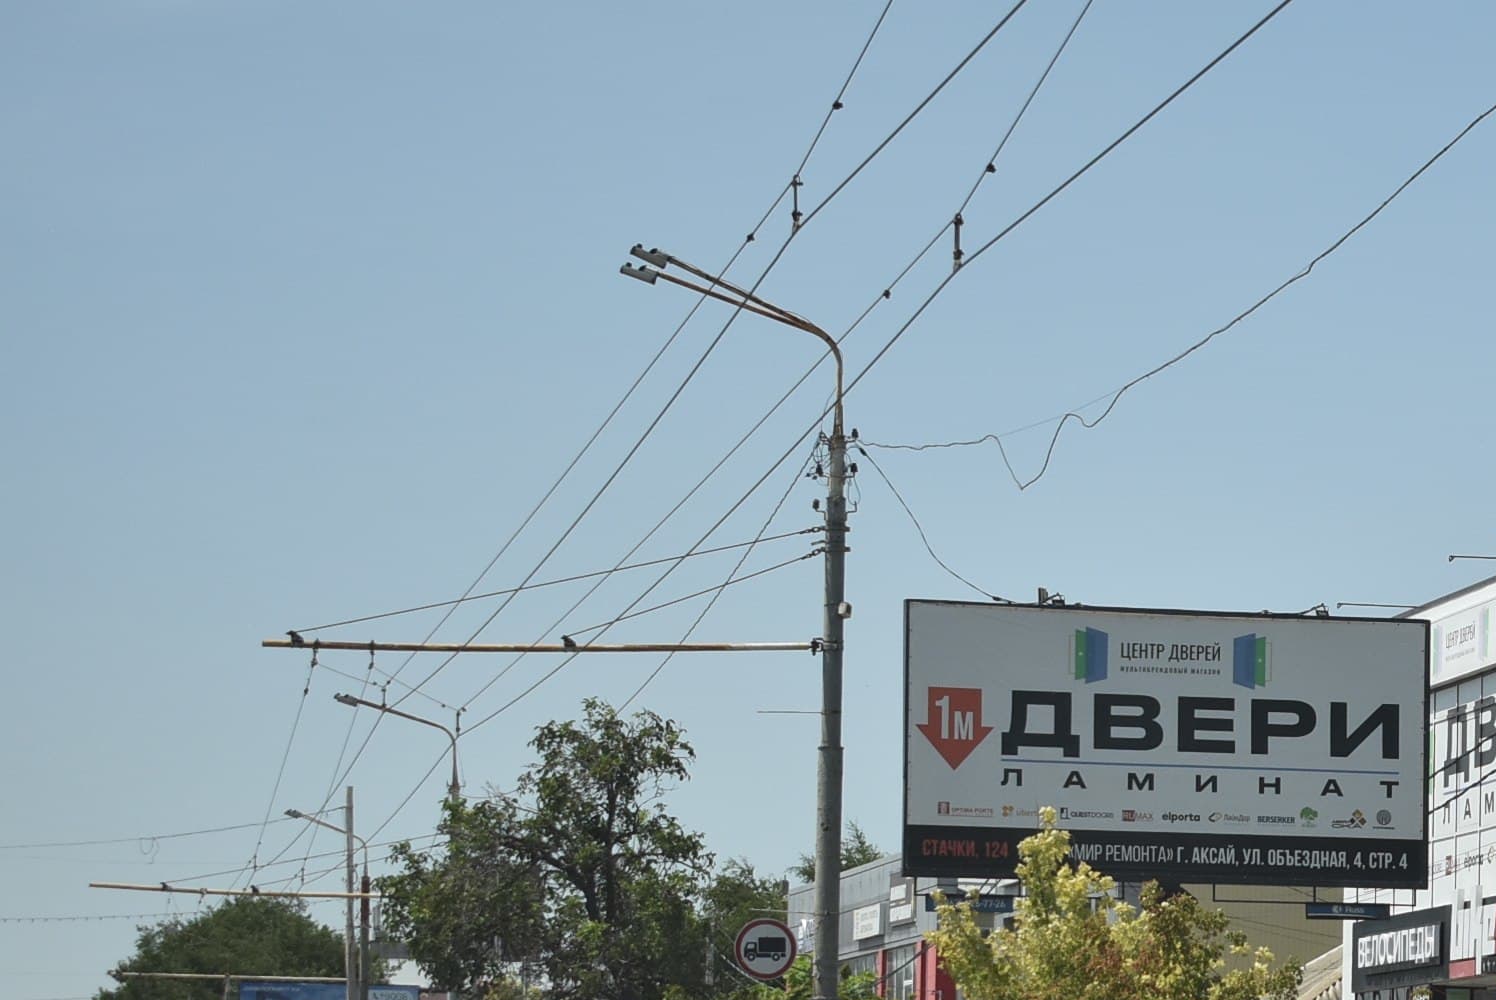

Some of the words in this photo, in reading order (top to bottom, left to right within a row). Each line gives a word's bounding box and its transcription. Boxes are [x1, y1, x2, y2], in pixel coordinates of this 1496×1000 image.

[1120, 642, 1165, 661] ЦЕНТР
[1168, 641, 1221, 663] ДВЕРЕЙ
[1001, 690, 1400, 759] ДВЕРИ
[1000, 768, 1400, 799] ЛАМИНАТ
[1161, 811, 1201, 823] elporta
[1257, 815, 1296, 824] BERSERKER
[922, 839, 979, 858] СТАЧКИ,
[985, 842, 1009, 858] 124
[1105, 844, 1174, 863] РЕМОНТА»
[1176, 847, 1188, 863] Г.
[1191, 845, 1239, 866] АКСАЙ,
[1243, 849, 1265, 865] УЛ.
[1267, 850, 1350, 870] ОБЪЕЗДНАЯ,
[1353, 852, 1366, 871] 4,
[1368, 852, 1396, 870] СТР.
[1398, 853, 1408, 870] 4
[1357, 924, 1438, 969] ВЕЛОСИПЕДЫ
